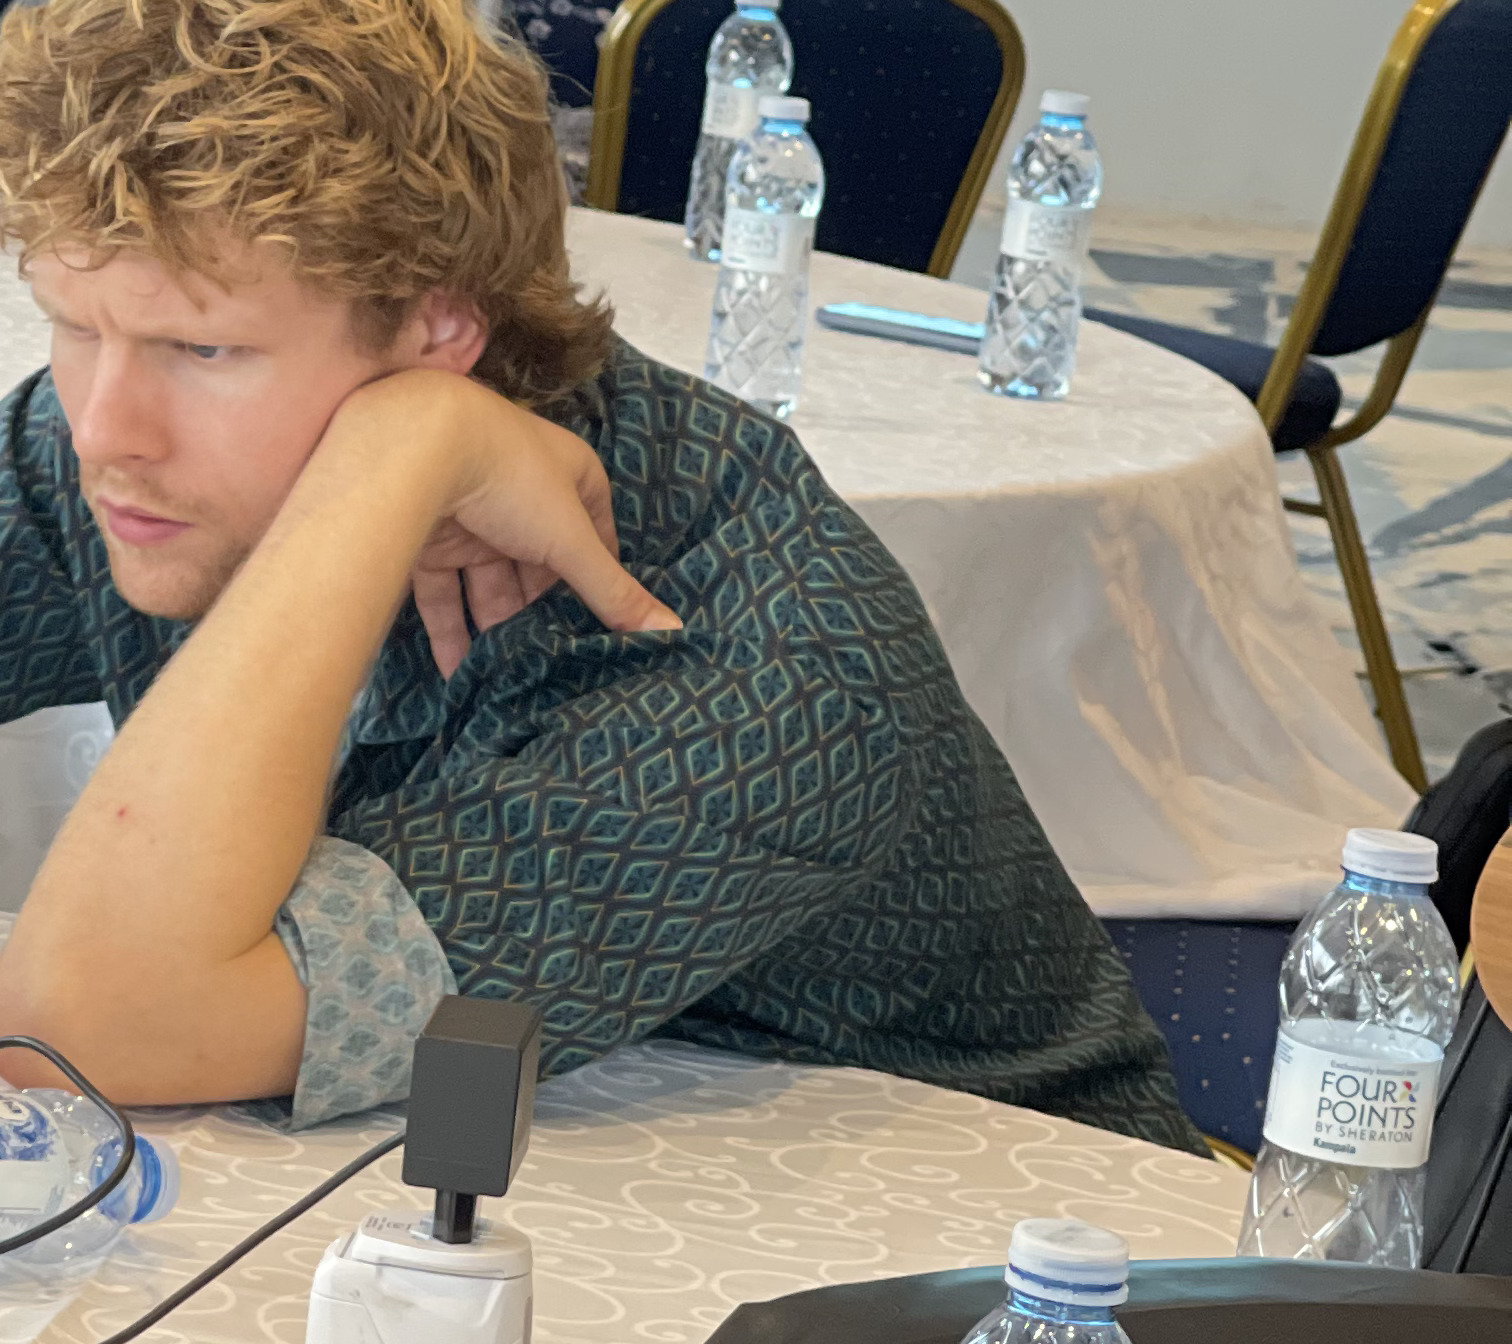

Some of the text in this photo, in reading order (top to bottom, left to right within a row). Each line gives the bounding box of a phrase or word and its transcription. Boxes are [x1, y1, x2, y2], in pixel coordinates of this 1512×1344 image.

[1320, 1071, 1398, 1104] FOUR
[1317, 1096, 1416, 1130] POINTS
[1314, 1120, 1413, 1143] BY SHERATON
